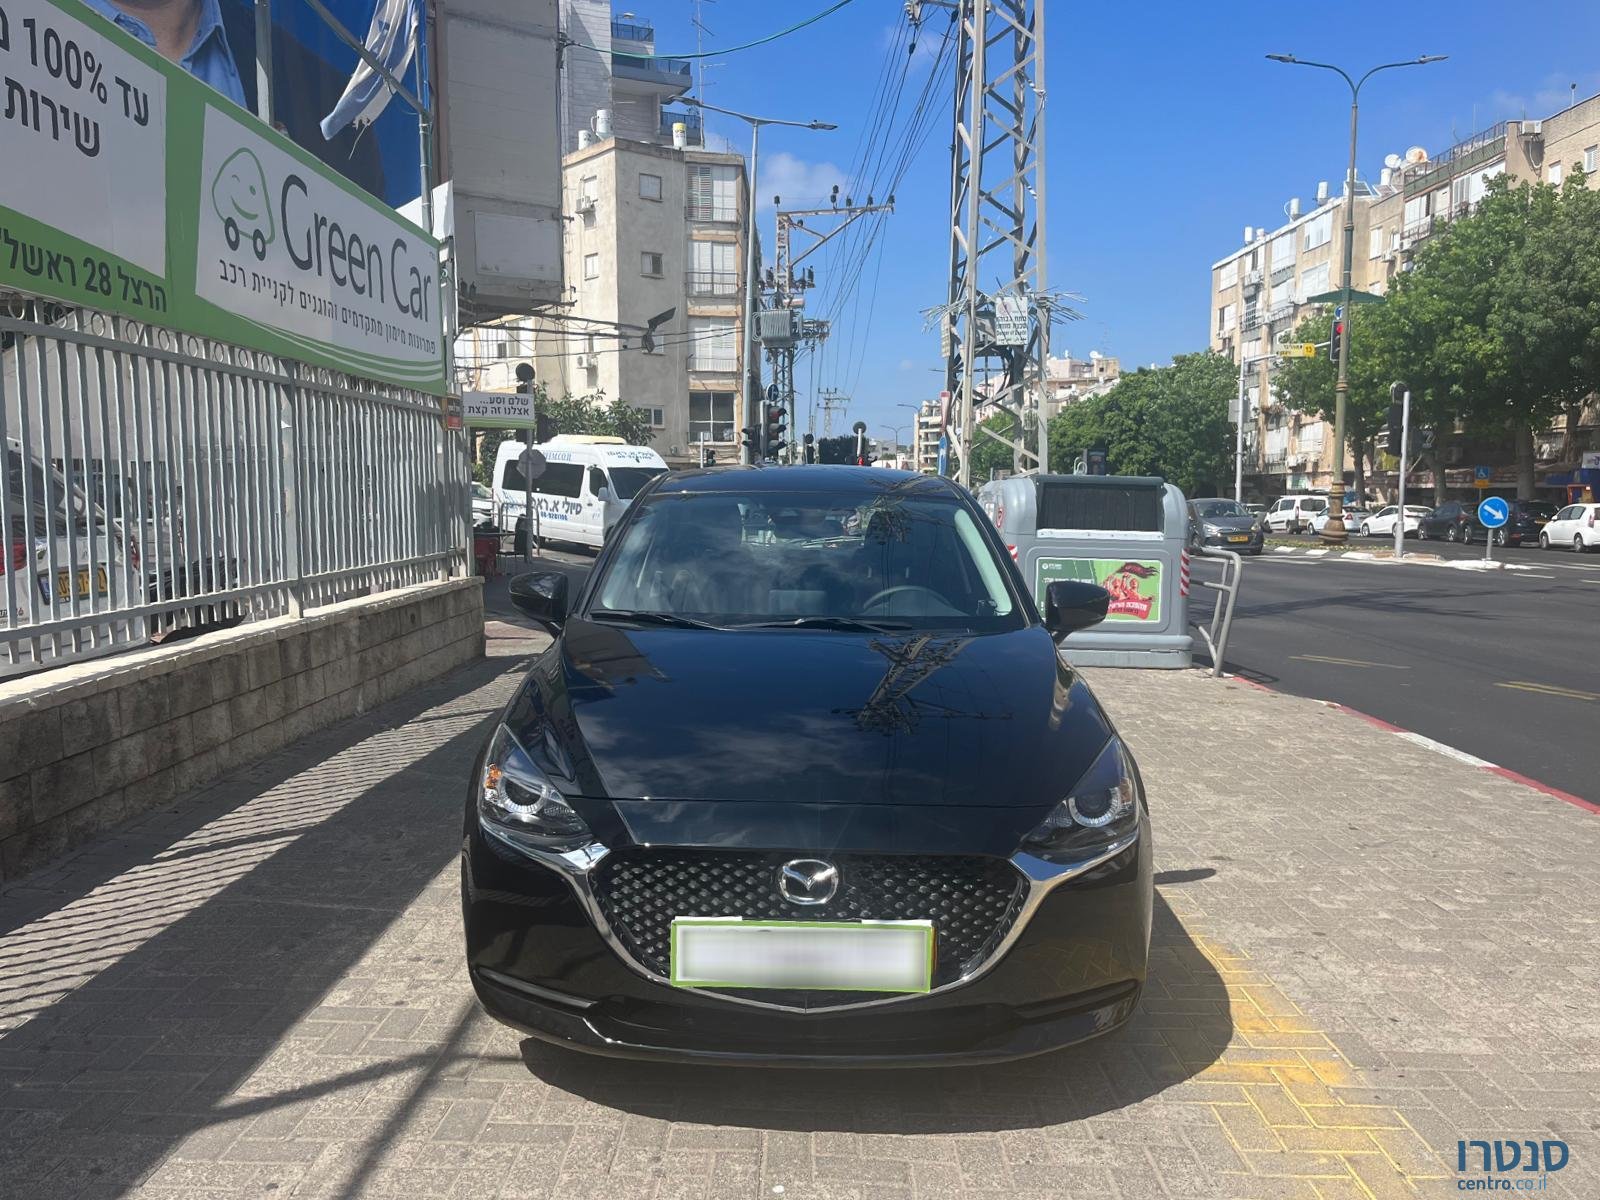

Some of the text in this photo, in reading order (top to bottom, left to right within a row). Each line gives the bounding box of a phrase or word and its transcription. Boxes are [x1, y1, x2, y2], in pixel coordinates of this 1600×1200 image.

[23, 18, 107, 104] 100%
[5, 76, 100, 157] שירות
[115, 76, 149, 126] עד
[0, 227, 167, 312] הרצל 28 ראשל
[281, 174, 431, 323] Green Car
[220, 259, 436, 355] פתרונות מימון מתקדמים והוגנים לקניית רכב
[468, 406, 488, 416] קצת
[480, 396, 529, 405] שלם וסע...
[491, 406, 501, 414] זה
[504, 406, 529, 416] אצלנו
